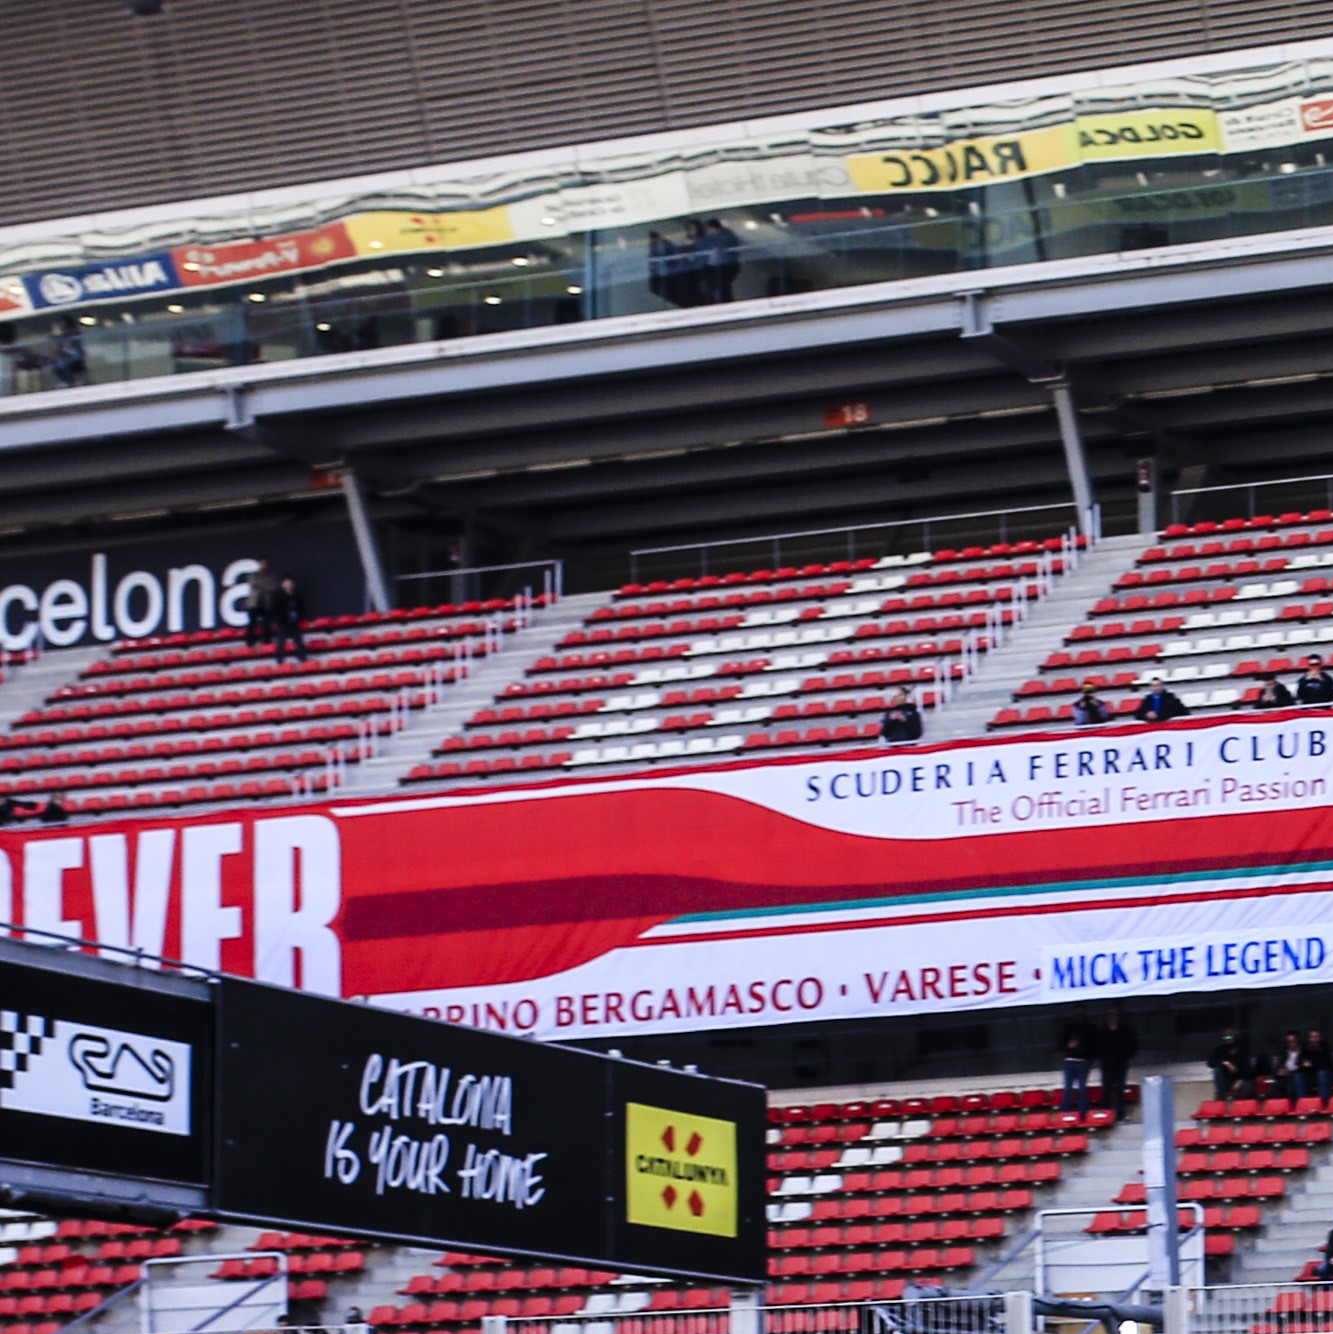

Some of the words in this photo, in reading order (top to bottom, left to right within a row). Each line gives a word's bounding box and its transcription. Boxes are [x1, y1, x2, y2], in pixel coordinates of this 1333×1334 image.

[806, 757, 1008, 802] SCUDERIA
[1028, 741, 1197, 782] FERRARI
[1218, 728, 1330, 764] CLUB
[951, 799, 1003, 827] The
[1010, 788, 1111, 821] Official
[1119, 777, 1213, 814] Ferrari
[1219, 773, 1328, 804] Passion
[1050, 952, 1130, 989] MICK
[1137, 945, 1196, 980] THE
[1205, 935, 1326, 978] LEGEND
[554, 976, 825, 1029] BERGAMASCO
[863, 960, 1019, 1004] VARESE
[90, 1096, 165, 1126] Barcelona
[324, 1119, 361, 1185] IS
[368, 1124, 451, 1195] YOUR
[456, 1143, 548, 1210] HOME
